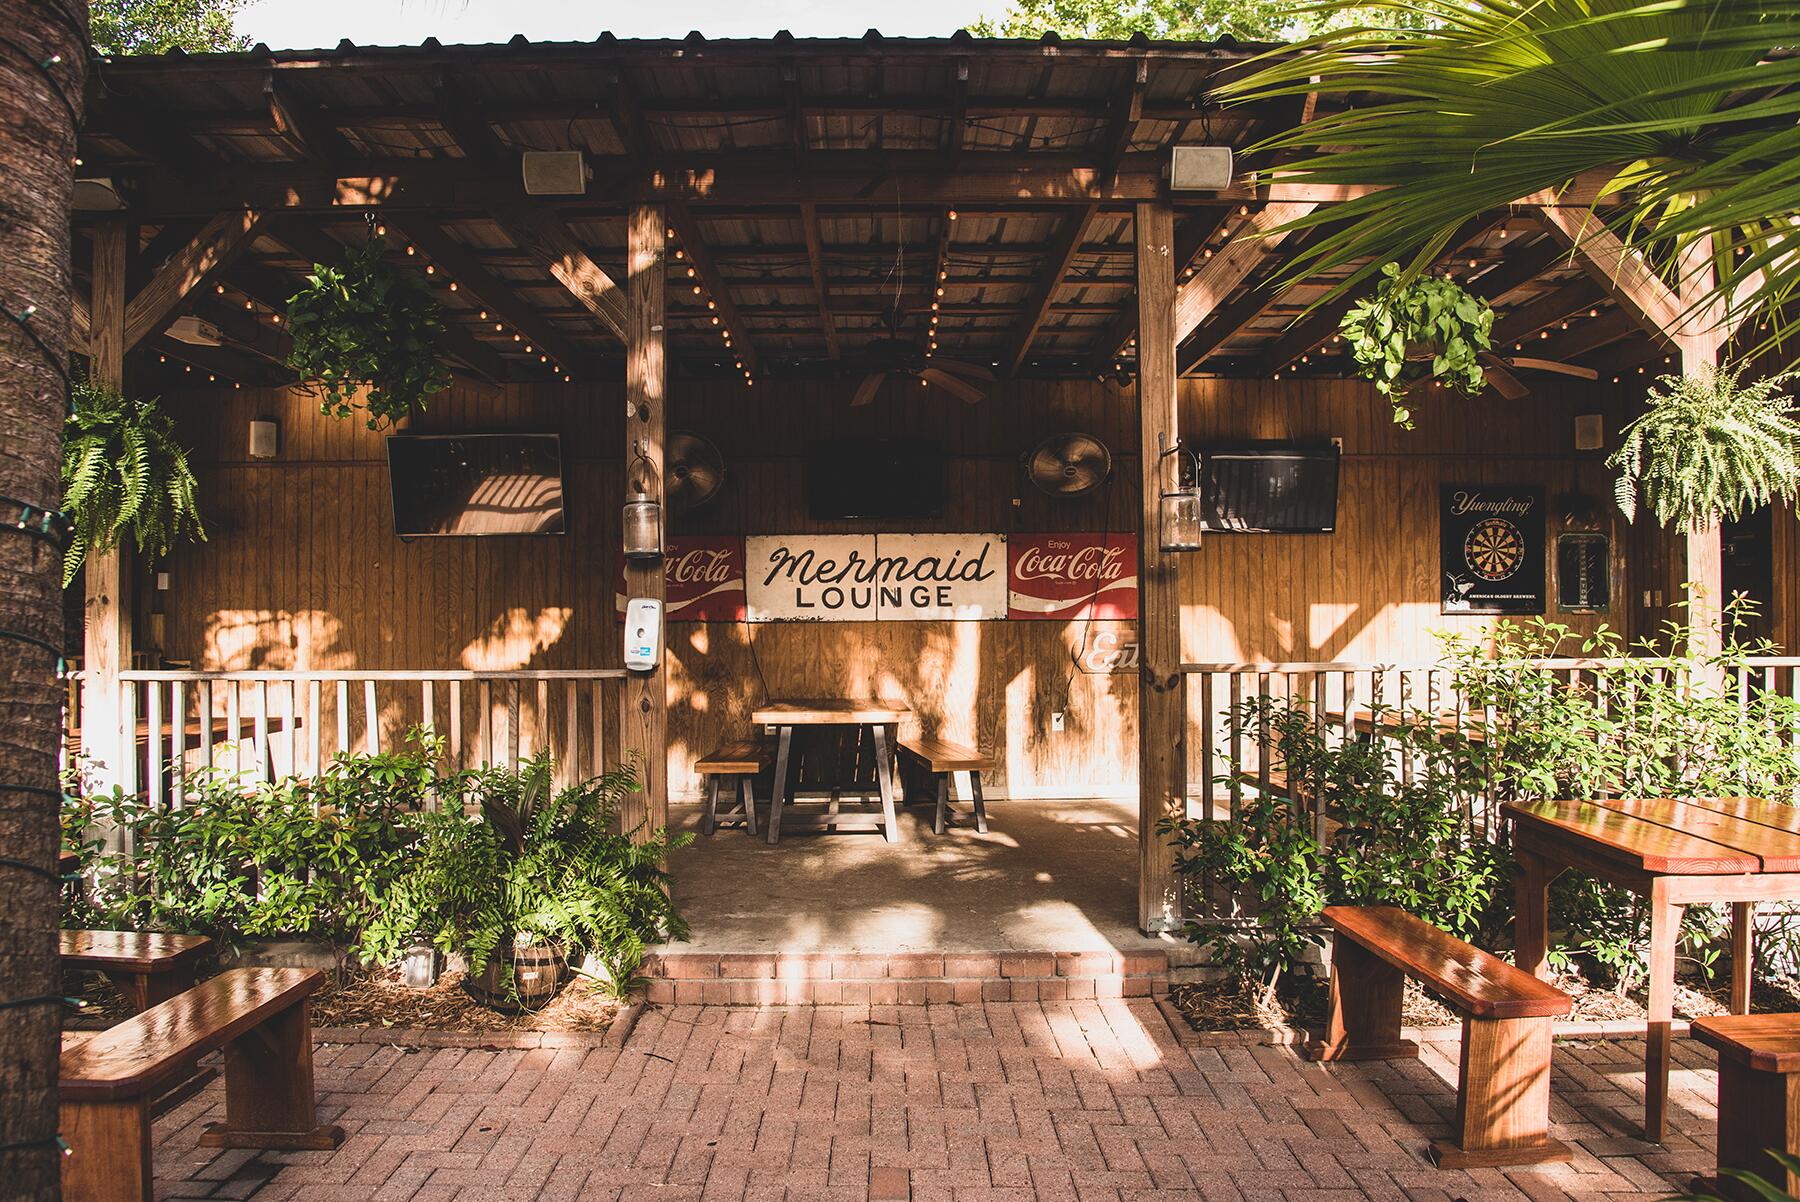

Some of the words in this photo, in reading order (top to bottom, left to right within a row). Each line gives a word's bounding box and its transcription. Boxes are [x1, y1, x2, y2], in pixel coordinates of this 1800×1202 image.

[1451, 491, 1535, 516] Yuengling
[1048, 540, 1071, 549] Enjoy
[763, 541, 995, 586] Mermaid
[1015, 547, 1126, 580] Coca-Cola
[796, 586, 953, 609] LOUNGE
